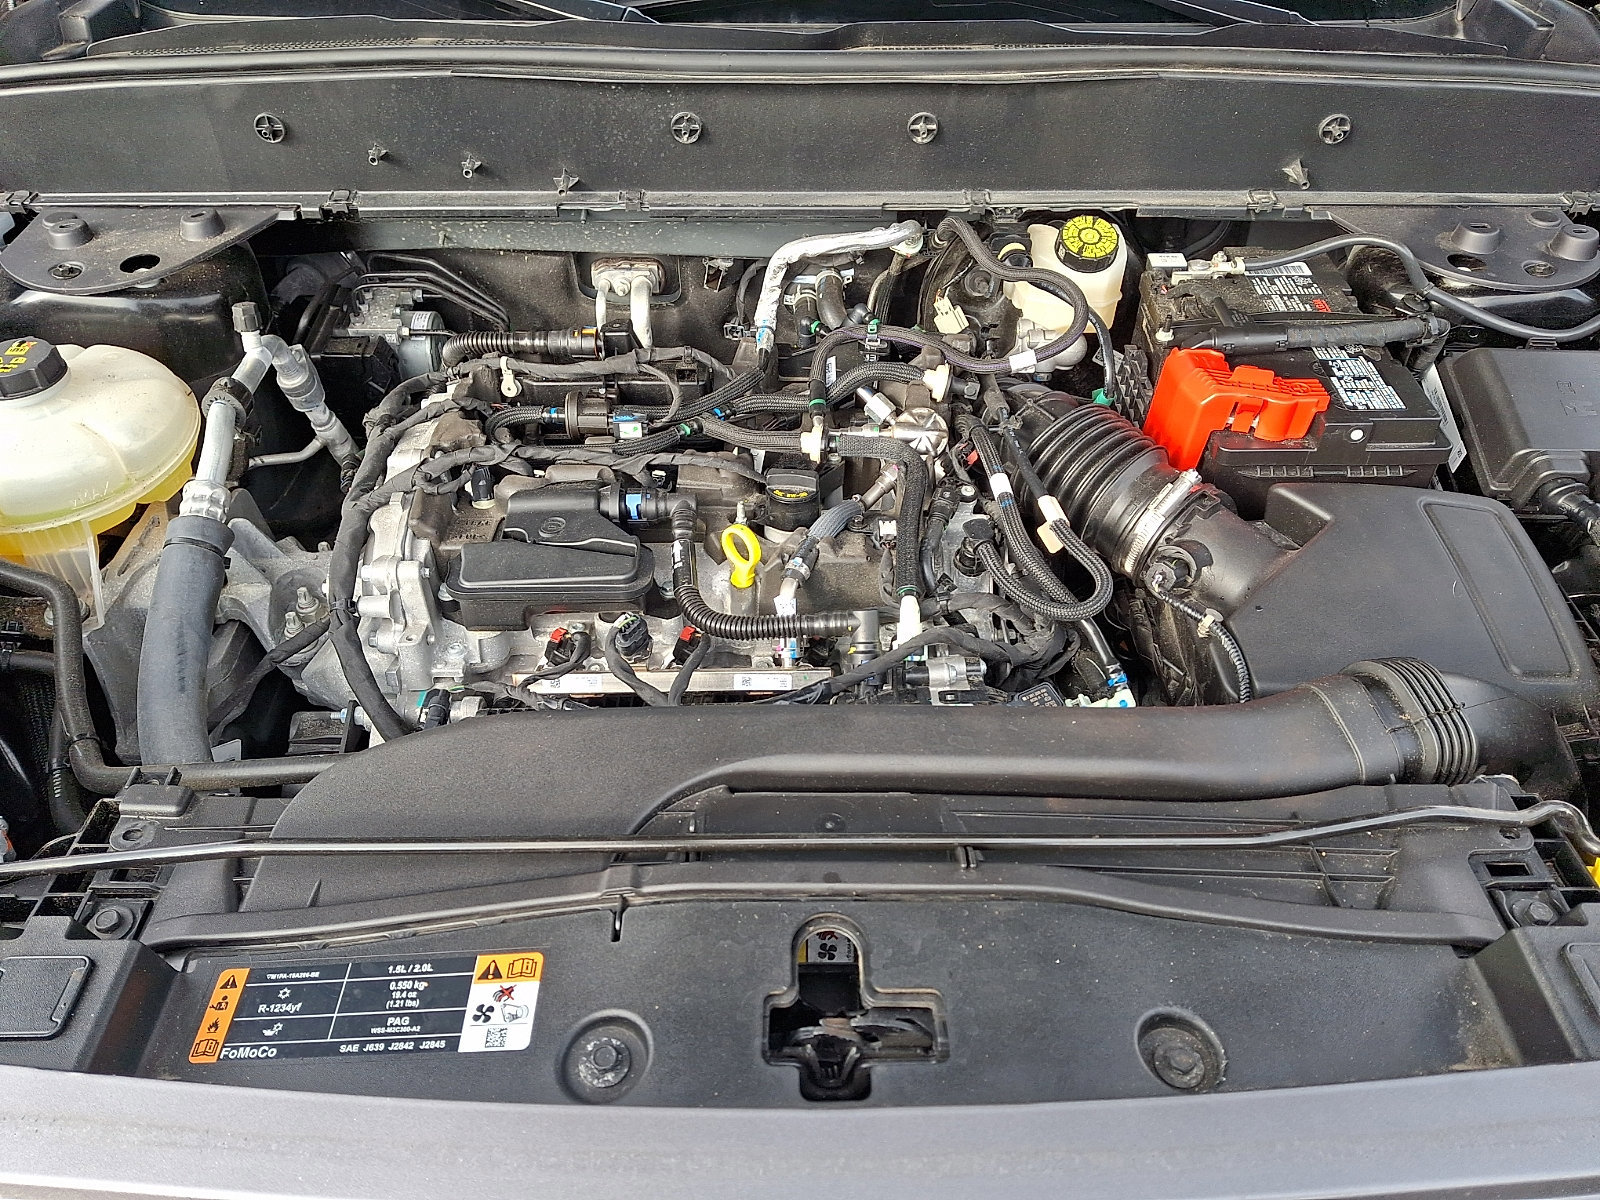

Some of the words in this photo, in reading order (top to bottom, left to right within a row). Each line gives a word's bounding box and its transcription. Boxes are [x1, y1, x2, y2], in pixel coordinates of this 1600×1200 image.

[389, 981, 413, 991] 0.550
[257, 1002, 302, 1014] R-1234yf
[386, 1016, 410, 1026] PAG
[220, 1045, 278, 1059] FoMoCo
[339, 1043, 360, 1053] SAE
[362, 1042, 385, 1052] J639
[387, 1041, 415, 1051] J2842
[418, 1039, 446, 1049] J2845
